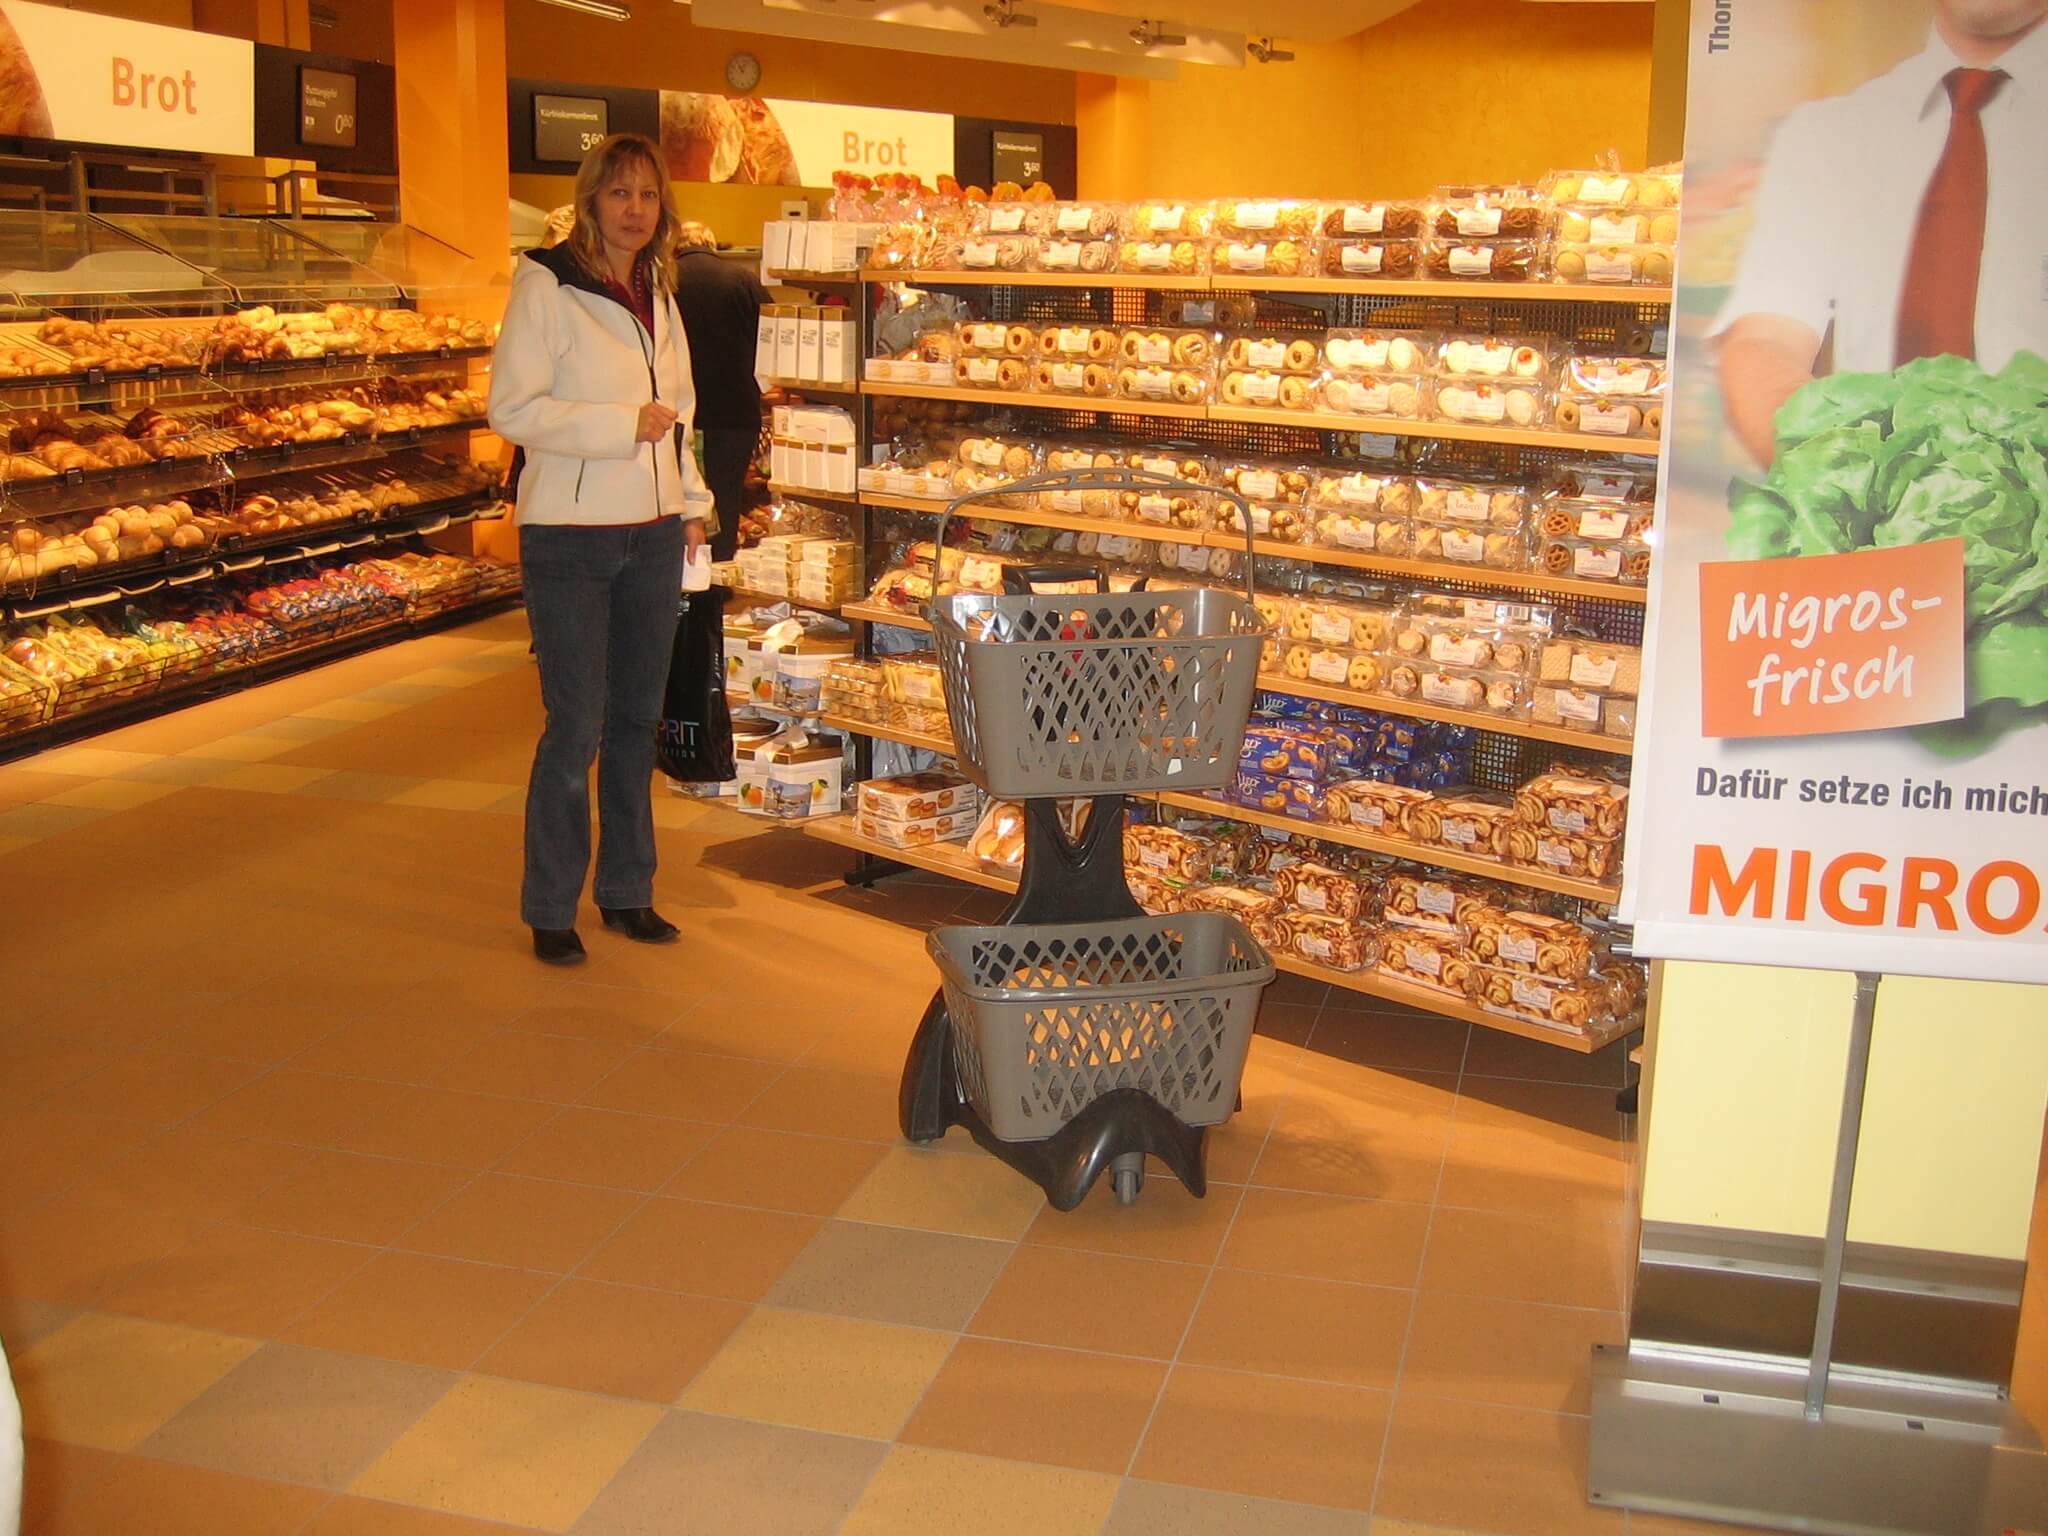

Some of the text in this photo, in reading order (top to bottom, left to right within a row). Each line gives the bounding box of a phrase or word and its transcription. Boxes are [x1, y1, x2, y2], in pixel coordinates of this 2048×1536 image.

[112, 56, 198, 115] Brot
[843, 130, 908, 167] Brot
[1727, 587, 1942, 649] Migros-
[1746, 644, 1915, 717] frisch
[1695, 766, 2048, 816] Dafür setze ich mich
[1688, 843, 2048, 936] MIGRO
